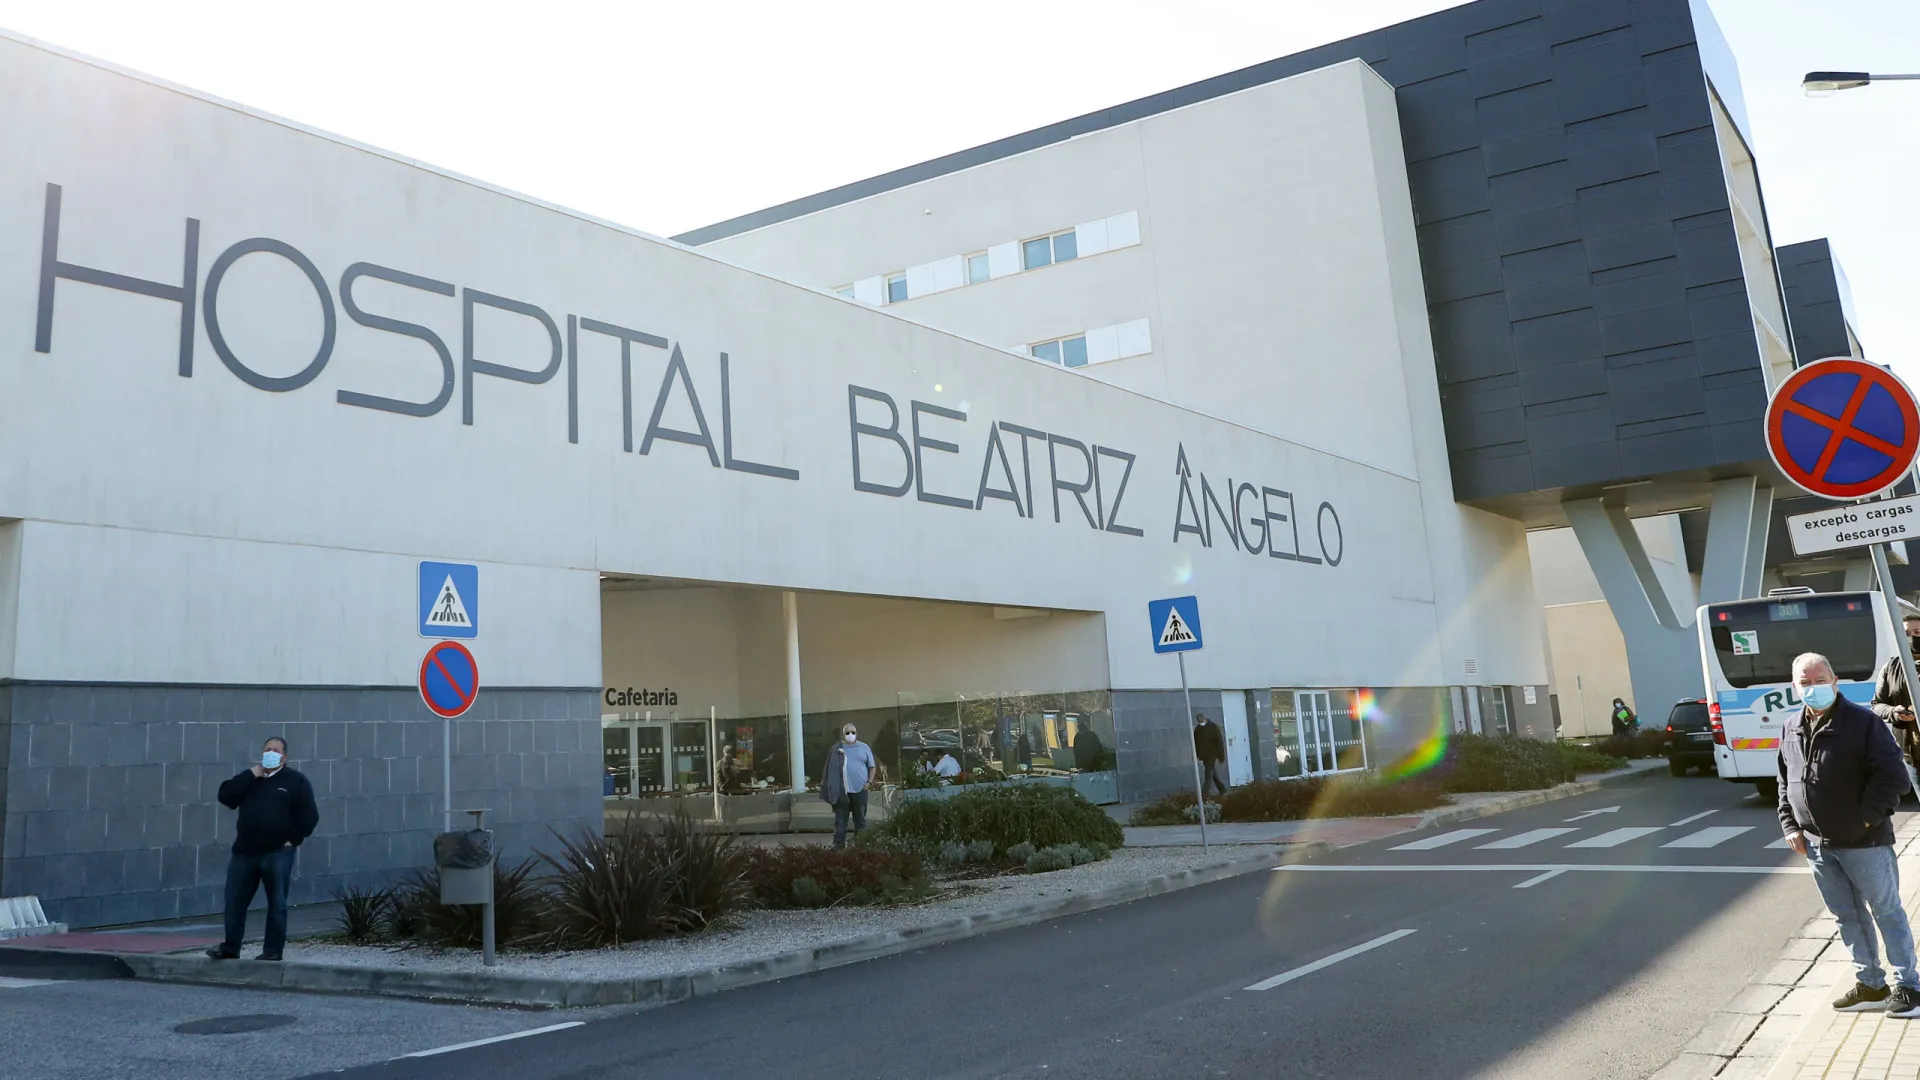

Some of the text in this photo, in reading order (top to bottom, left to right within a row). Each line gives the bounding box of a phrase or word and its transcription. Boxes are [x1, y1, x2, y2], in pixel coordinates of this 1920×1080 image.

[35, 183, 1343, 567] HOSPITAL BEATRIZ ÂNGELO
[1804, 504, 1913, 530] excepto cargas
[1835, 524, 1906, 543] descargas
[605, 687, 678, 706] Cafetaria
